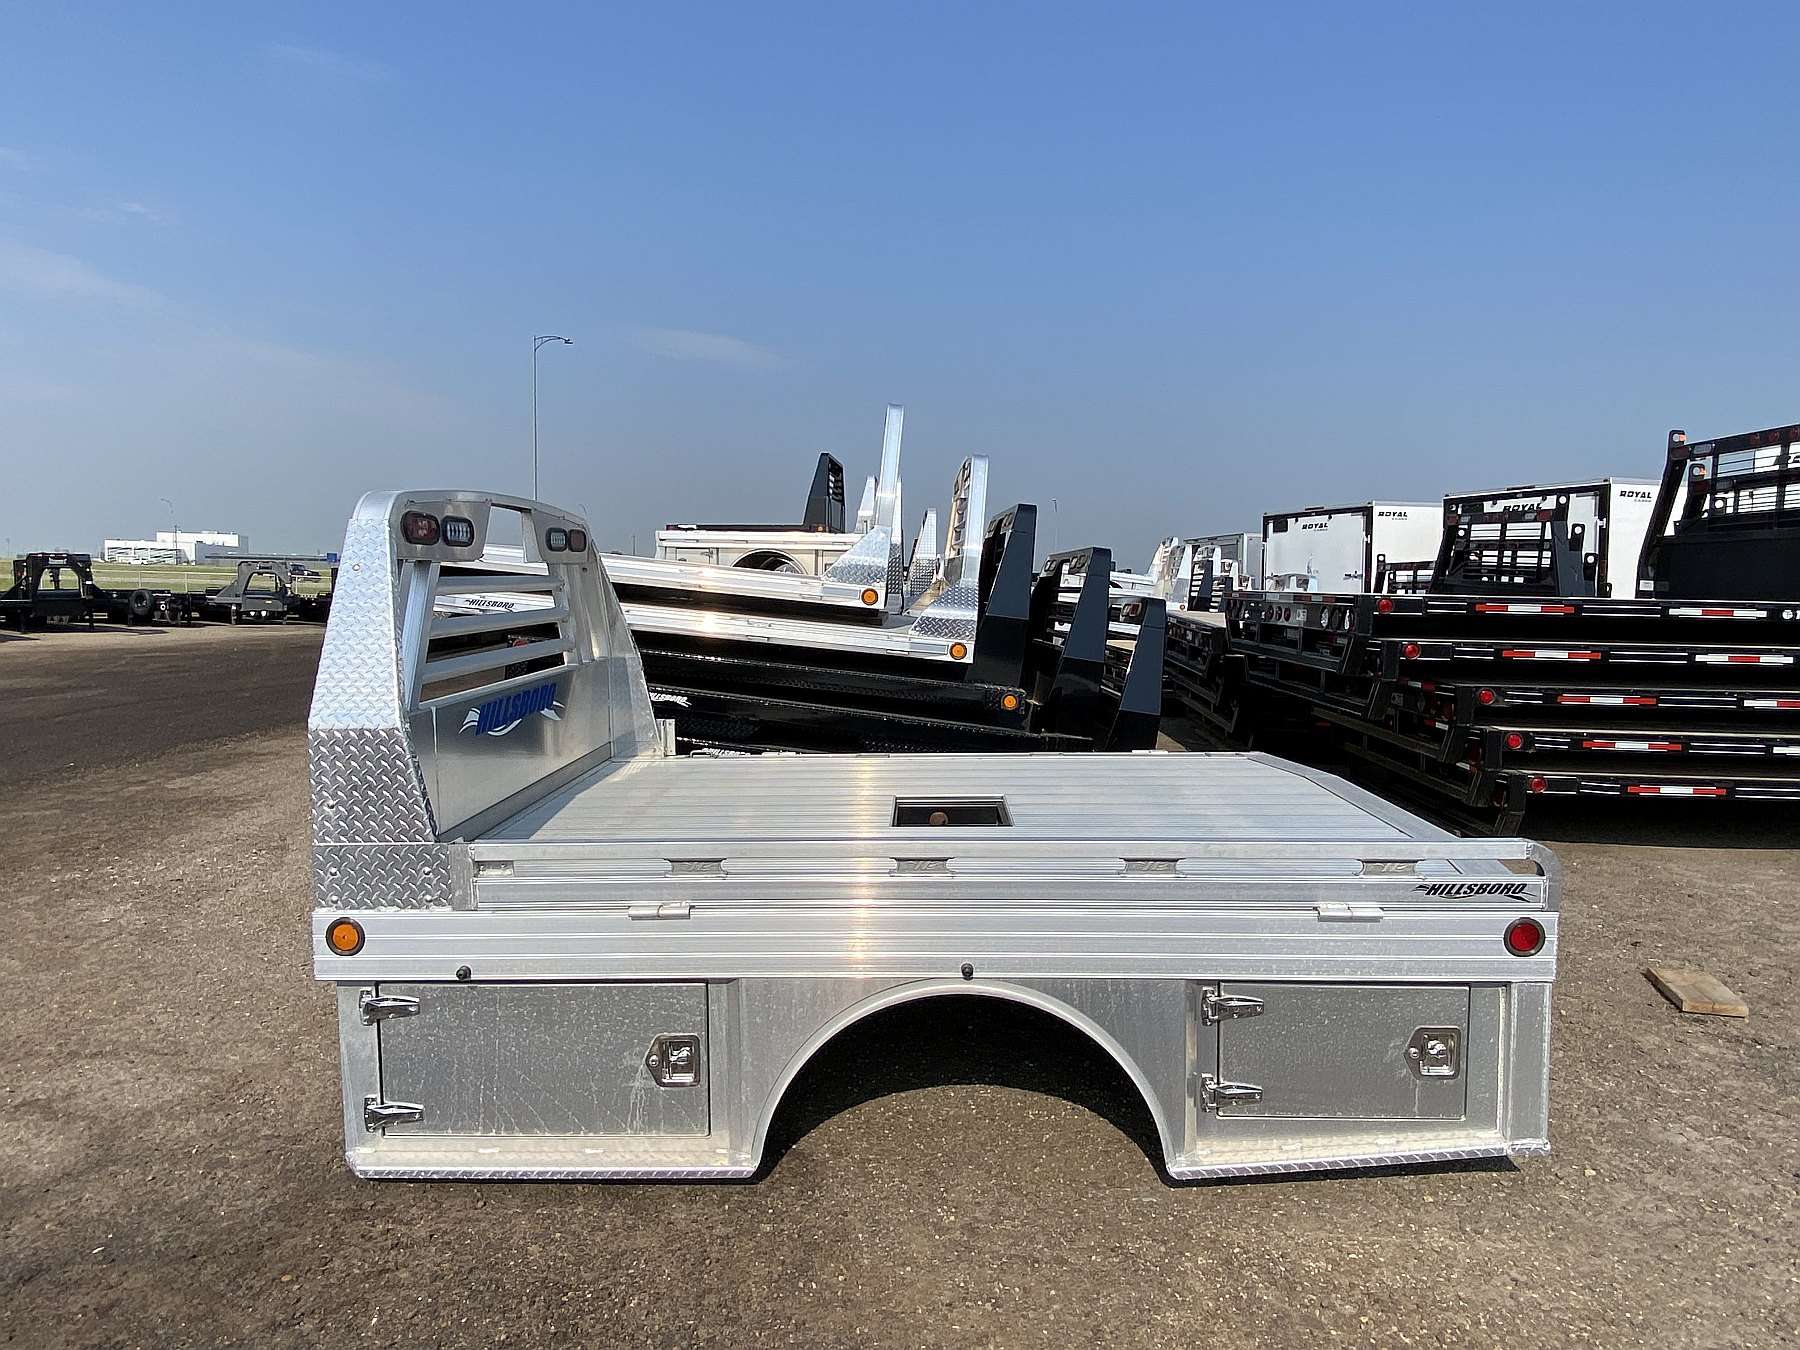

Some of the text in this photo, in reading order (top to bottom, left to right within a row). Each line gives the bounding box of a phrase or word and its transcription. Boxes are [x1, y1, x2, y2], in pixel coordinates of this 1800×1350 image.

[1619, 490, 1652, 499] ROYAL
[1502, 502, 1543, 512] ROYAL
[1301, 522, 1329, 530] ROYAL
[467, 598, 515, 609] HILLSBORO
[649, 691, 688, 703] ILLSBORO
[475, 681, 559, 736] HILLSBORO
[1425, 883, 1528, 896] HILLSBORO
